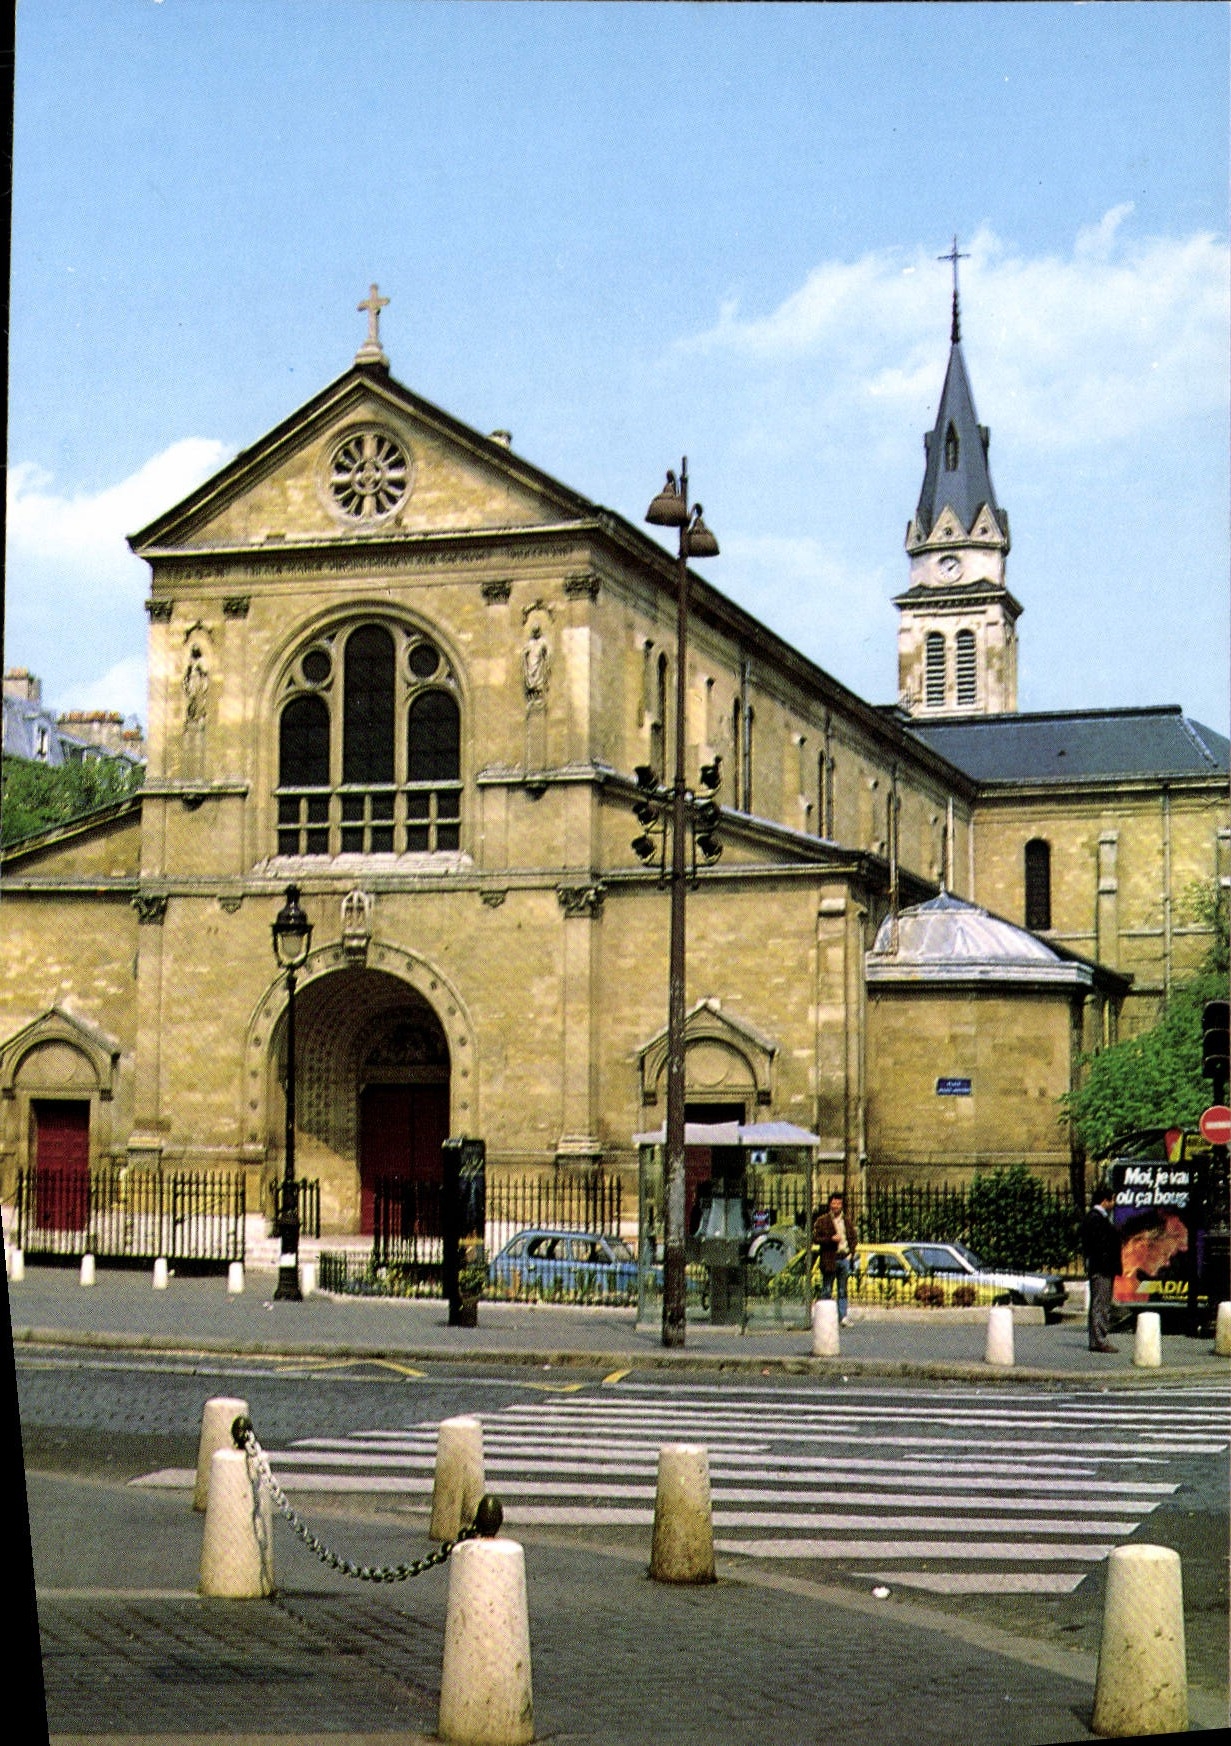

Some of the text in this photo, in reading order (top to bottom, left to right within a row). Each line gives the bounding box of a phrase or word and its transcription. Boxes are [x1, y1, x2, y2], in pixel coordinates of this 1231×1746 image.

[1124, 1167, 1153, 1188] Moi,
[1154, 1167, 1169, 1188] je
[1135, 1192, 1153, 1208] ça
